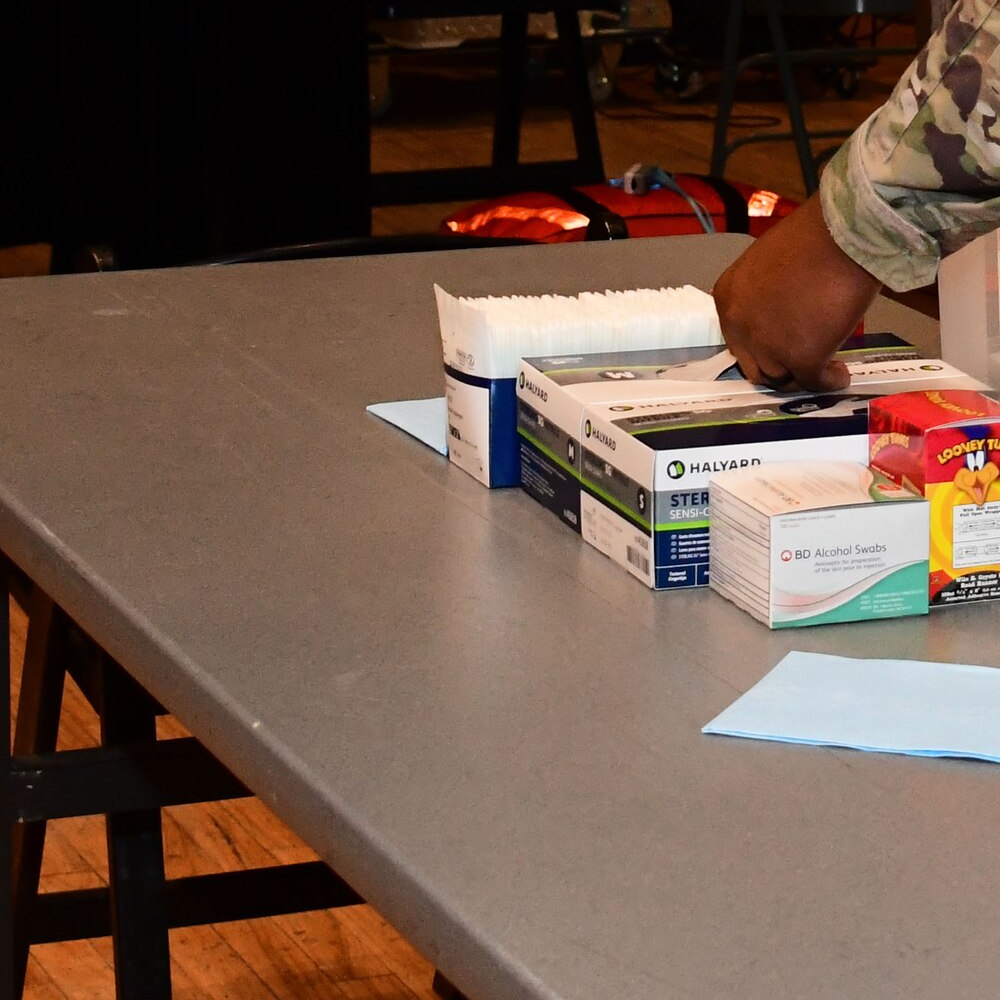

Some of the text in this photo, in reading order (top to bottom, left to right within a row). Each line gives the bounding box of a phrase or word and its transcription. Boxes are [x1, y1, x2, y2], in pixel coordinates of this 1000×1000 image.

[525, 382, 549, 403] HALYARD
[592, 427, 617, 451] HALYARD
[936, 438, 986, 465] LOONEY
[638, 494, 645, 513] S
[795, 542, 887, 560] BD Alcohol Swabs
